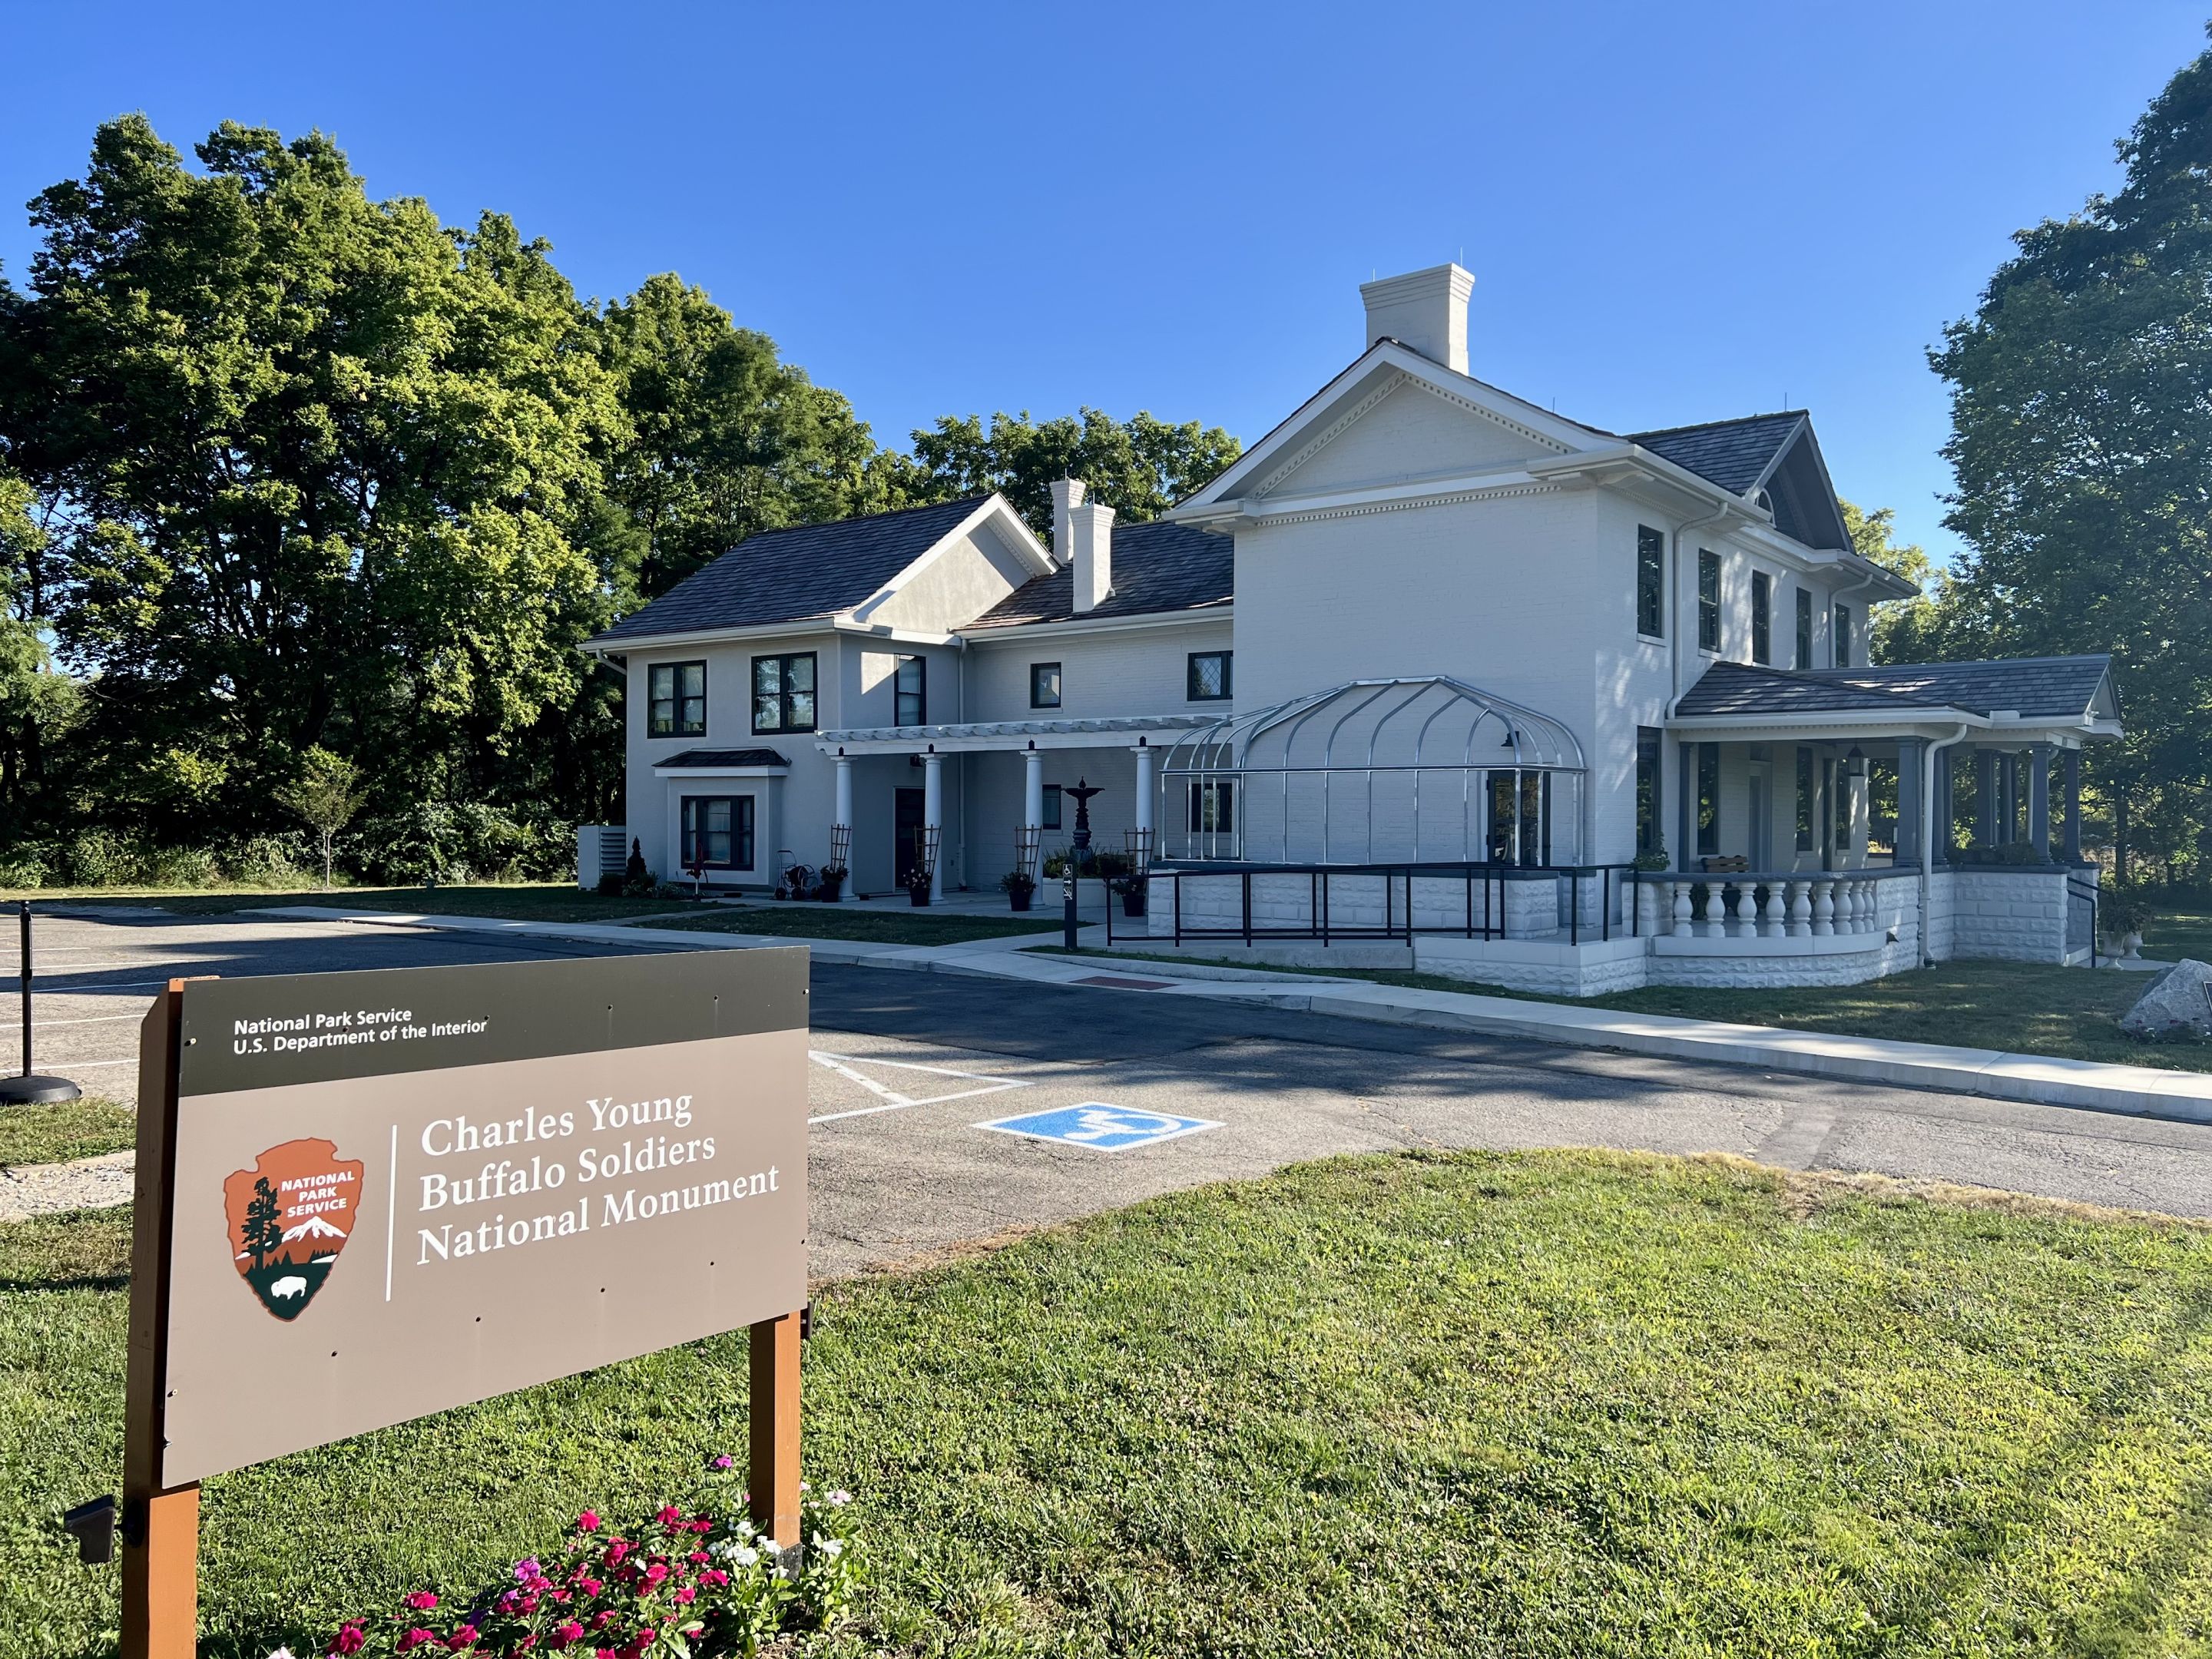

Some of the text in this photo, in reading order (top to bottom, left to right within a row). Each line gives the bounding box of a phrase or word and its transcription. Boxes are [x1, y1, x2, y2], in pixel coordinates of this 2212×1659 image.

[233, 1019, 488, 1055] U.S. Department of the Interior
[234, 1008, 412, 1035] National Park Service
[421, 1094, 693, 1156] Charles Young
[281, 1171, 355, 1192] NATIONAL
[419, 1136, 715, 1211] Buffalo Soldiers
[287, 1197, 347, 1218] SERVICE
[299, 1186, 338, 1203] PARK
[416, 1165, 780, 1266] National Monument
